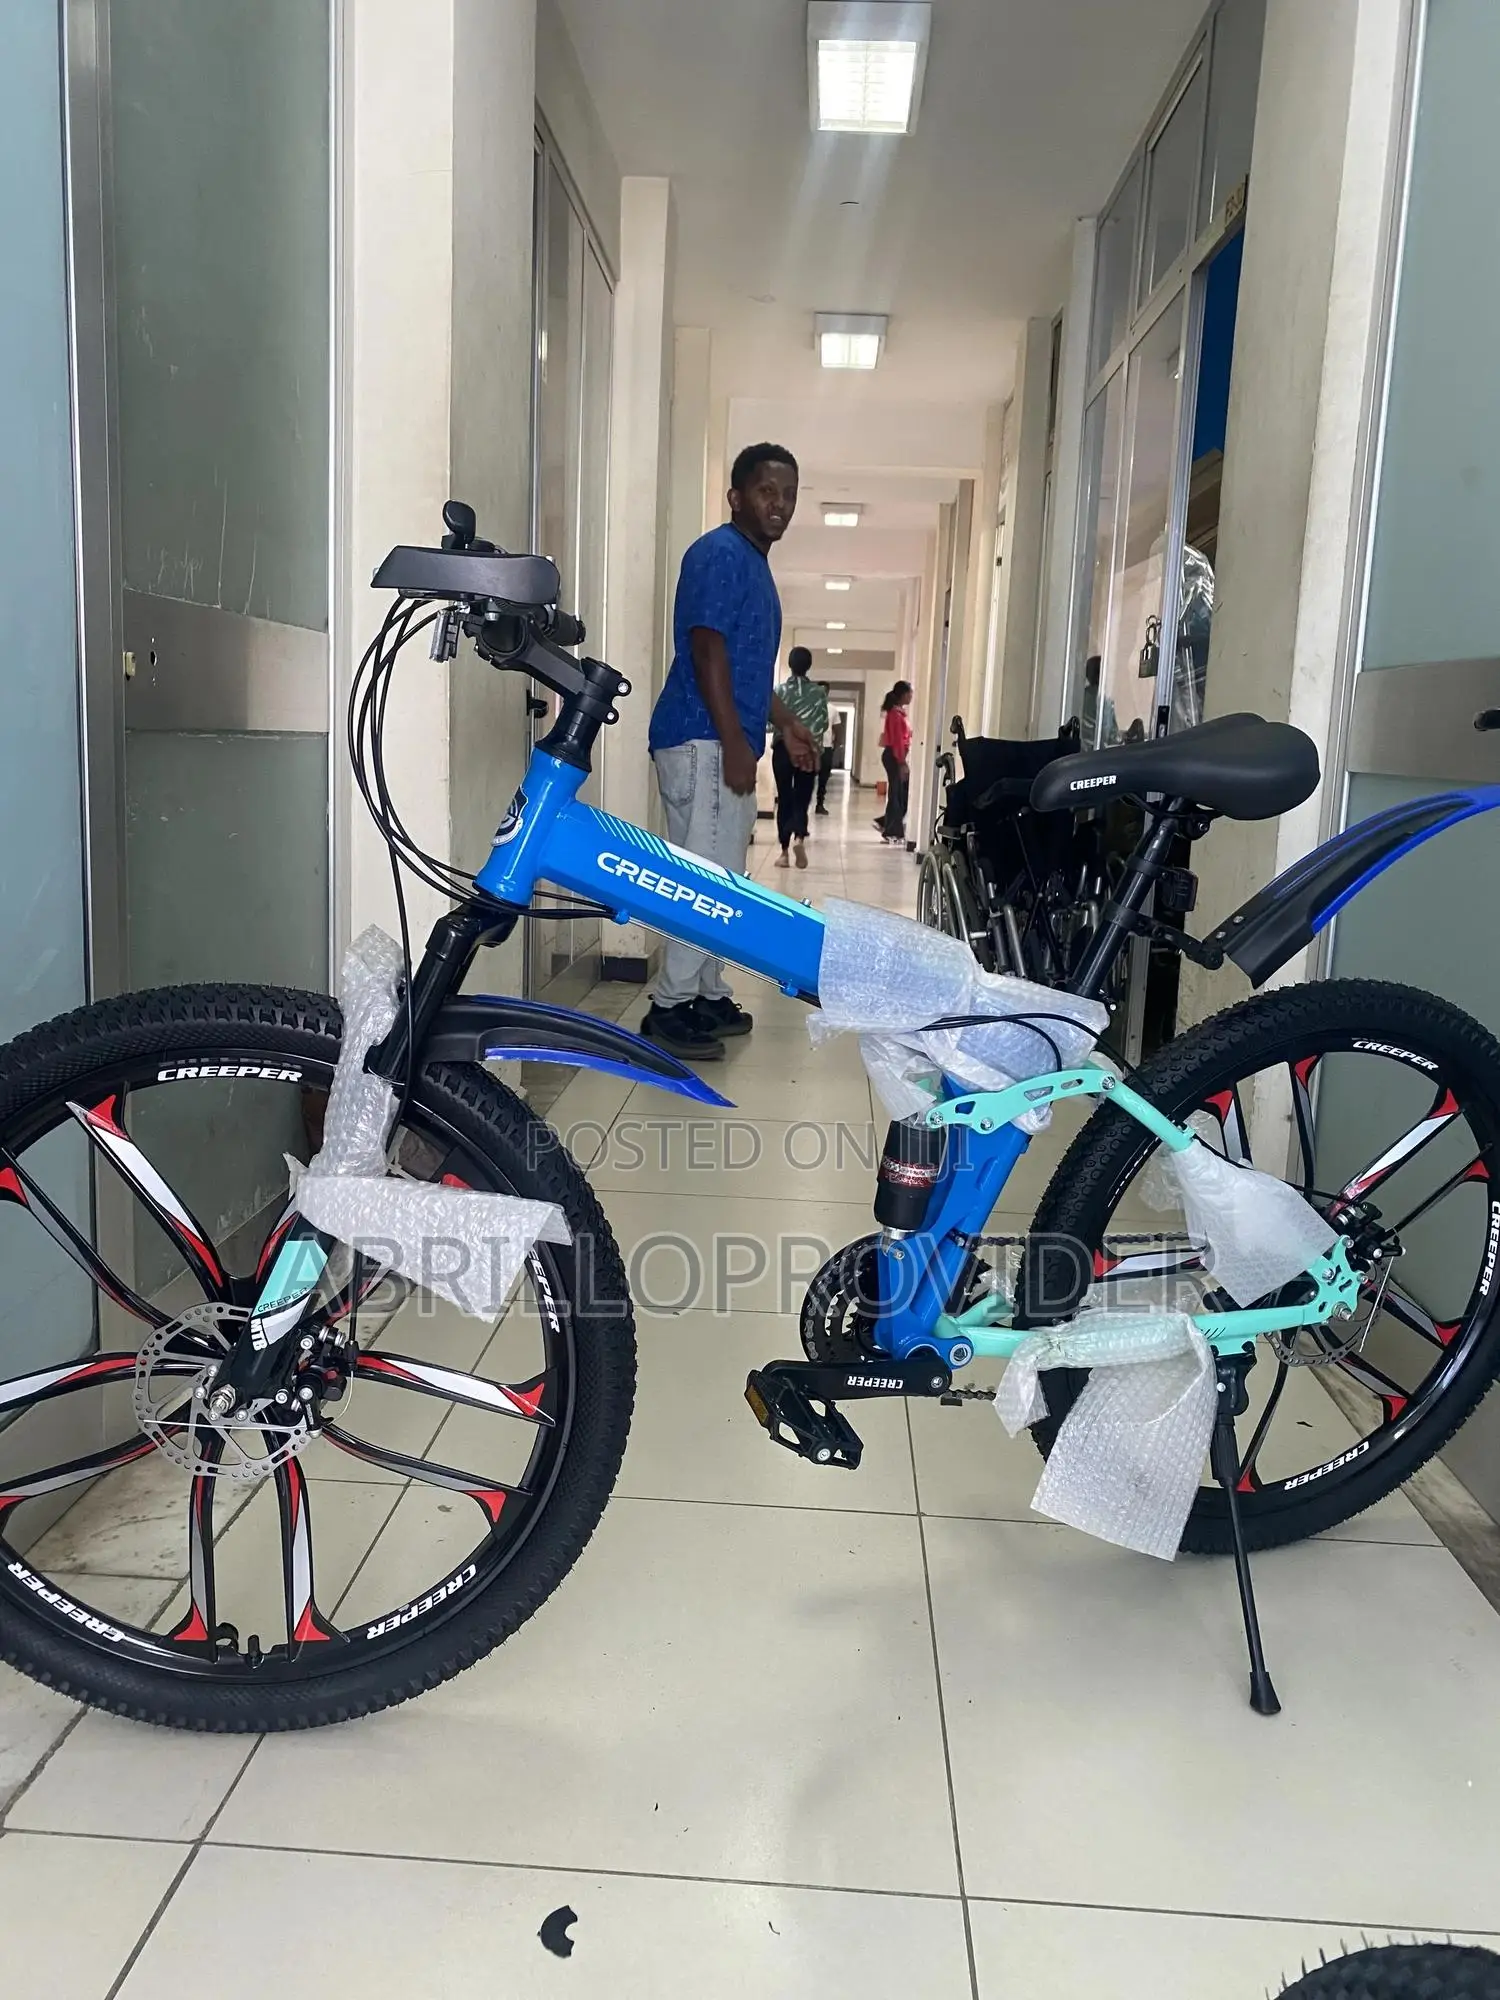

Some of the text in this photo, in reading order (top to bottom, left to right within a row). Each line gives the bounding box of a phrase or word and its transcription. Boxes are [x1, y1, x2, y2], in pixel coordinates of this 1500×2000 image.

[1070, 775, 1117, 791] CREEPER
[1352, 1041, 1439, 1070] CREEPER
[157, 1066, 303, 1082] CREEPER
[1479, 1200, 1500, 1296] CREEPER
[257, 1287, 308, 1313] CREEPER
[250, 1318, 268, 1351] MTB
[847, 1375, 904, 1389] CREEPER
[1284, 1440, 1370, 1491] CREEPER
[7, 1561, 124, 1642] CREEPER
[366, 1564, 477, 1640] CREEPER
